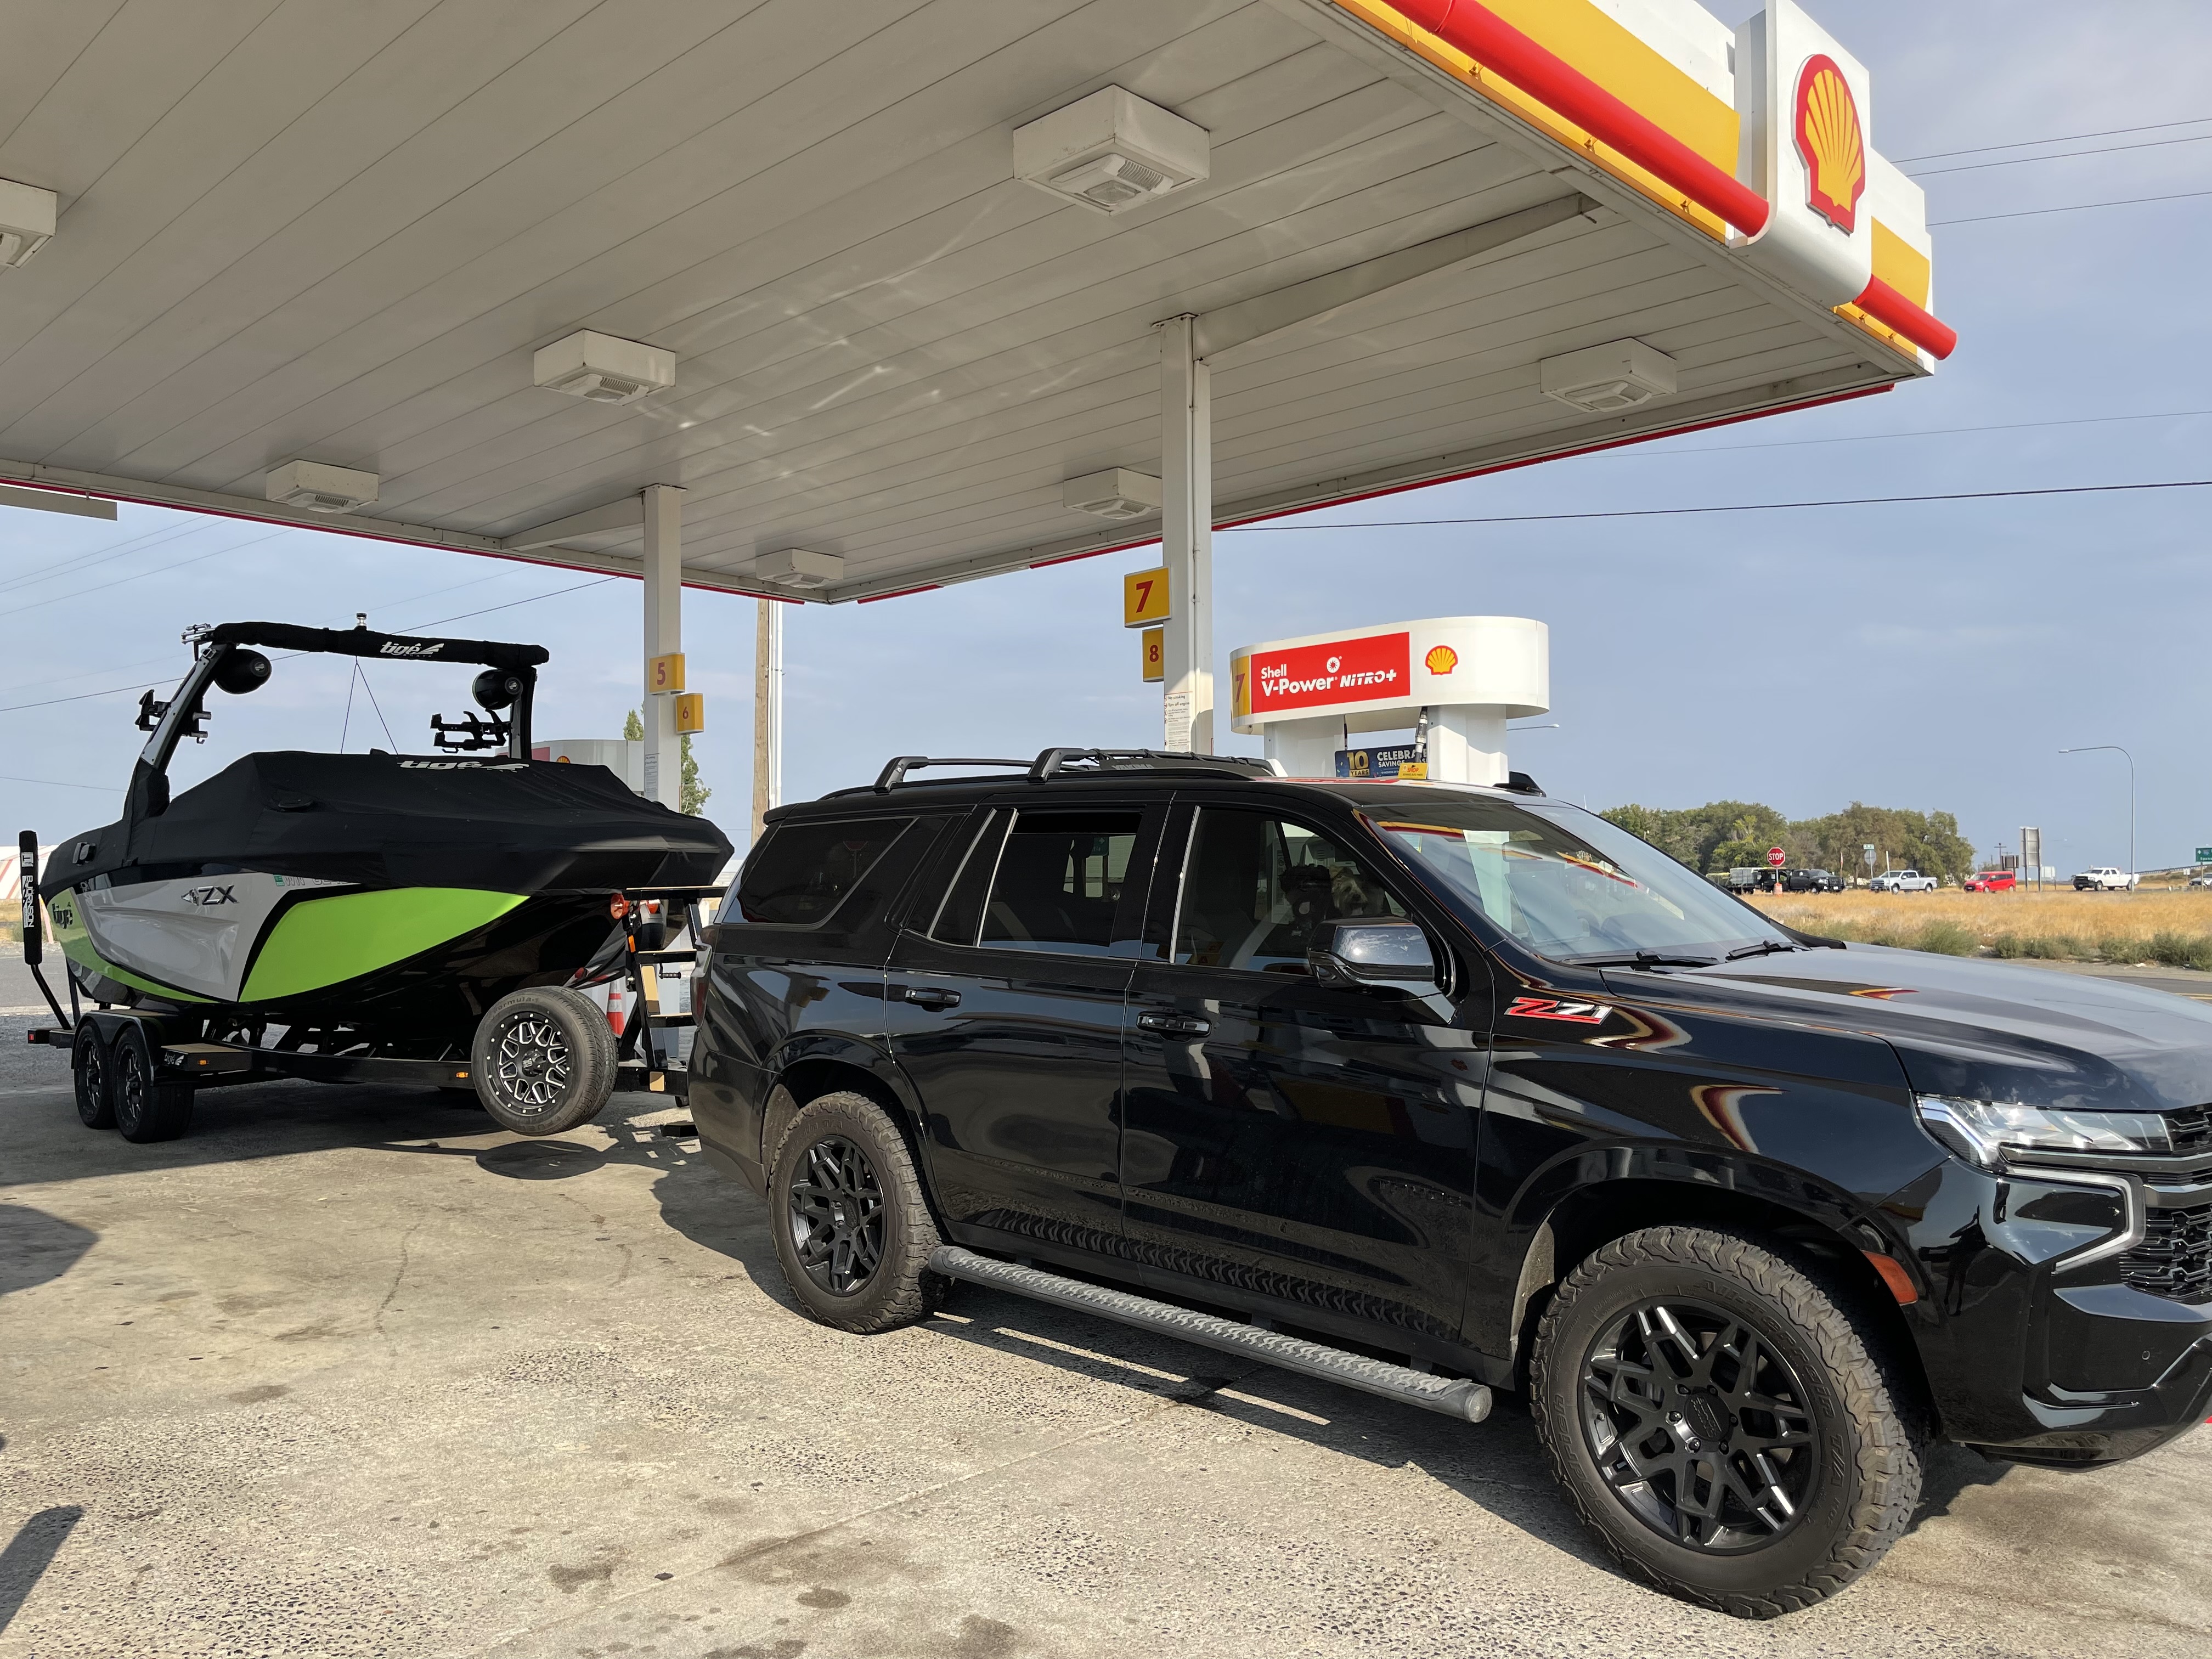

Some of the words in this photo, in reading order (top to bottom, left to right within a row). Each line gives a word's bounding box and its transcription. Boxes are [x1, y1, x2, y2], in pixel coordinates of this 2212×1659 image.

[1136, 580, 1154, 613] 7
[1149, 645, 1159, 663] 8
[657, 662, 666, 686] 5
[1261, 664, 1287, 680] Shell
[1235, 673, 1245, 703] 7
[1261, 676, 1334, 697] V-Power
[682, 706, 689, 720] 6
[1346, 750, 1369, 770] 10
[1768, 853, 1784, 861] STOP
[26, 875, 35, 928] BJÖRNSON
[1504, 996, 1613, 1026] Z71
